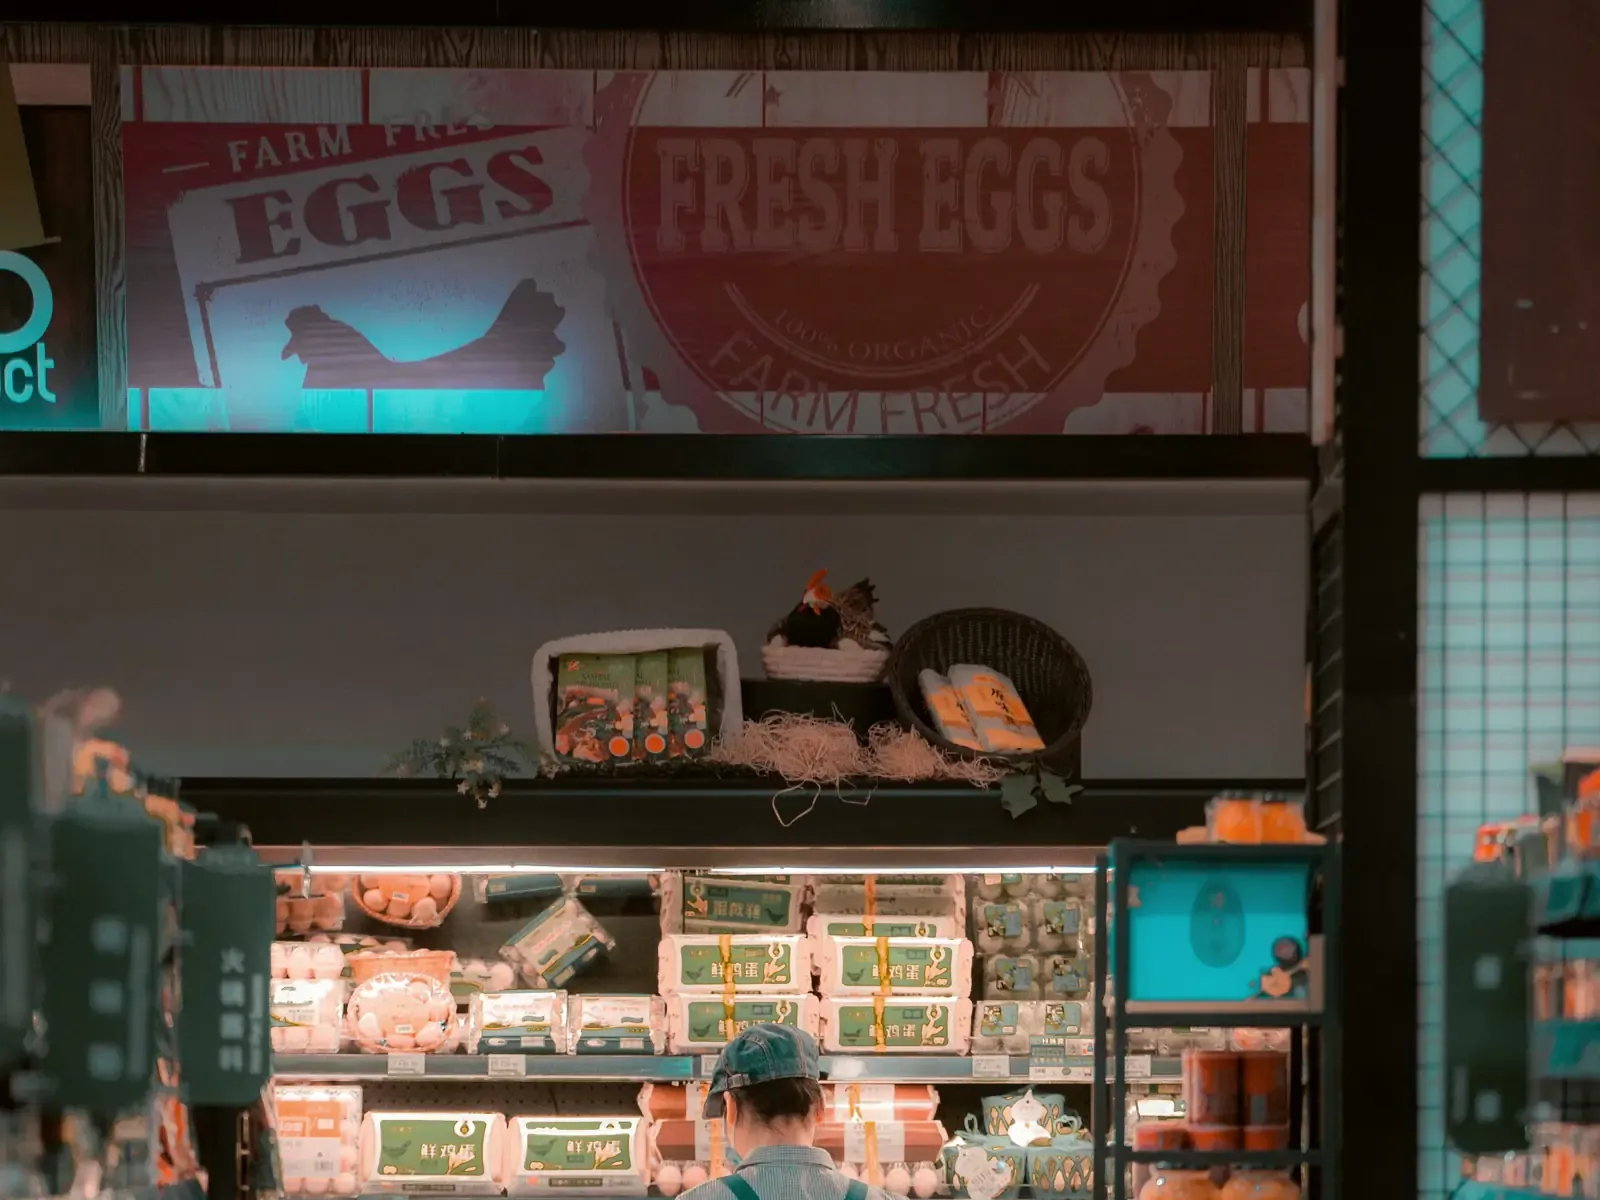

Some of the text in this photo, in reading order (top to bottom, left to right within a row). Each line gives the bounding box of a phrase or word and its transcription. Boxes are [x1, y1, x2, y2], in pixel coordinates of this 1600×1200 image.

[226, 127, 353, 173] FARM
[224, 145, 554, 265] EGGS
[656, 136, 1115, 256] FRESH EGGS
[0, 341, 56, 403] ct
[772, 304, 995, 361] 100% ORGANIC
[708, 329, 1052, 434] FARM FRESH
